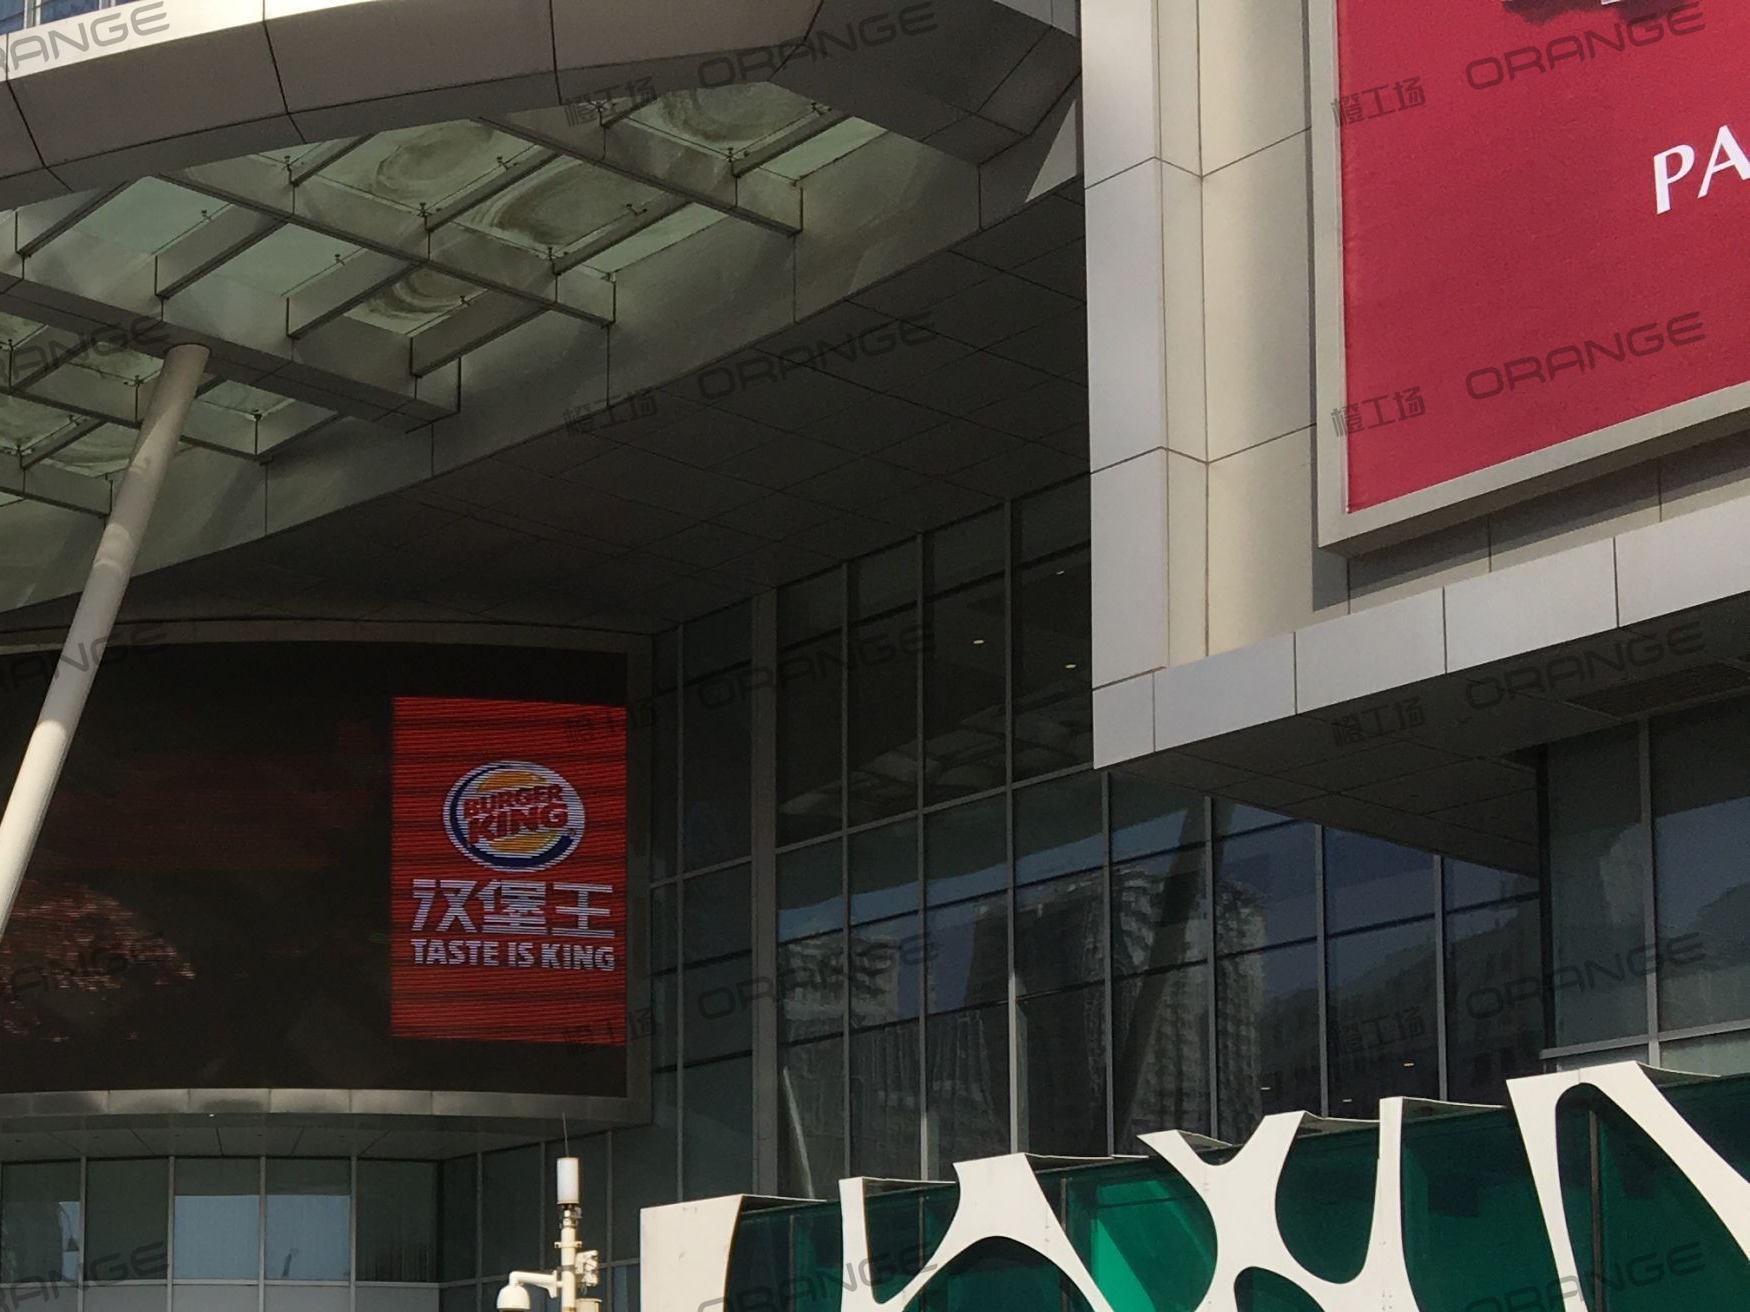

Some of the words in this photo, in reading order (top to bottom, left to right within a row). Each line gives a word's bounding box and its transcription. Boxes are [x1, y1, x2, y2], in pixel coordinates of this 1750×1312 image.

[1653, 124, 1750, 215] PA
[462, 784, 564, 819] BURGER
[467, 802, 569, 844] KING
[411, 879, 615, 938] 汉堡王
[410, 939, 499, 966] TASTE
[507, 941, 534, 968] IS
[541, 943, 615, 971] KING
